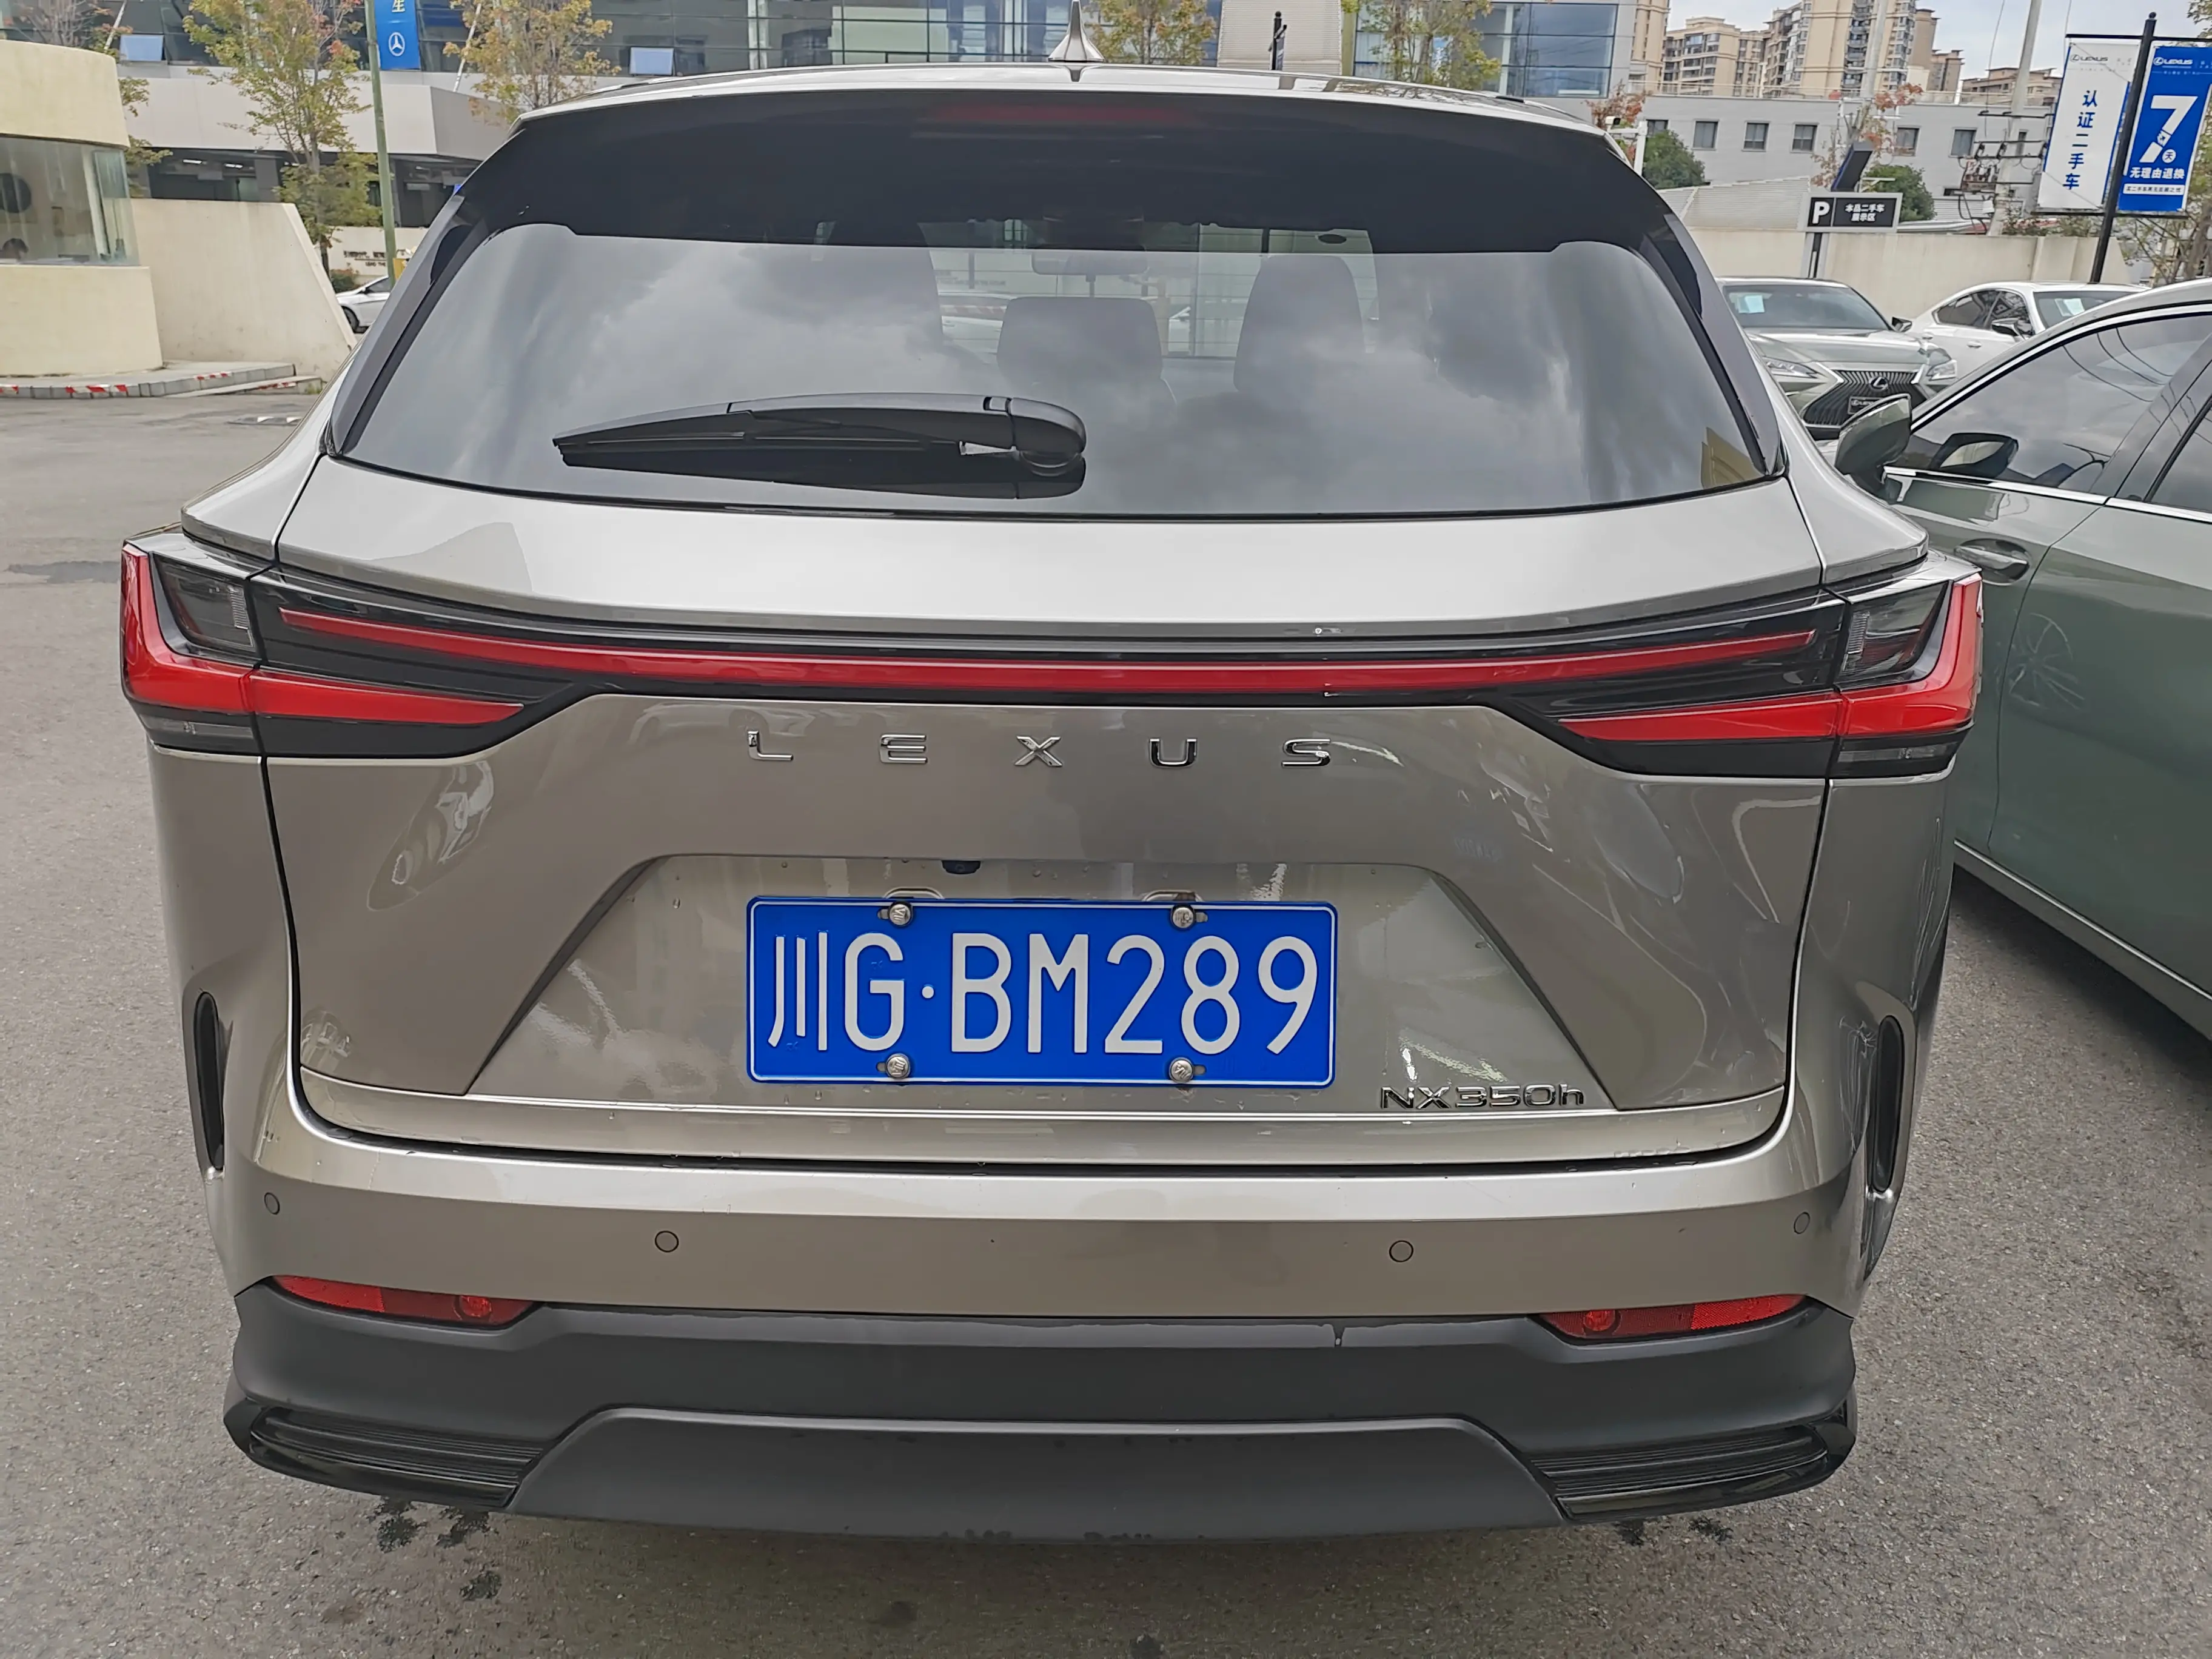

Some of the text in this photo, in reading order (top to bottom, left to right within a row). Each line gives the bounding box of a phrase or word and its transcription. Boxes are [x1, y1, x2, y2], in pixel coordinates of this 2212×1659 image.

[2062, 90, 2098, 190] 认证二手车
[2130, 167, 2185, 179] 无理由退换
[1812, 201, 1830, 224] P
[747, 730, 1332, 769] LEXUS
[1380, 1083, 1585, 1110] NX350h
